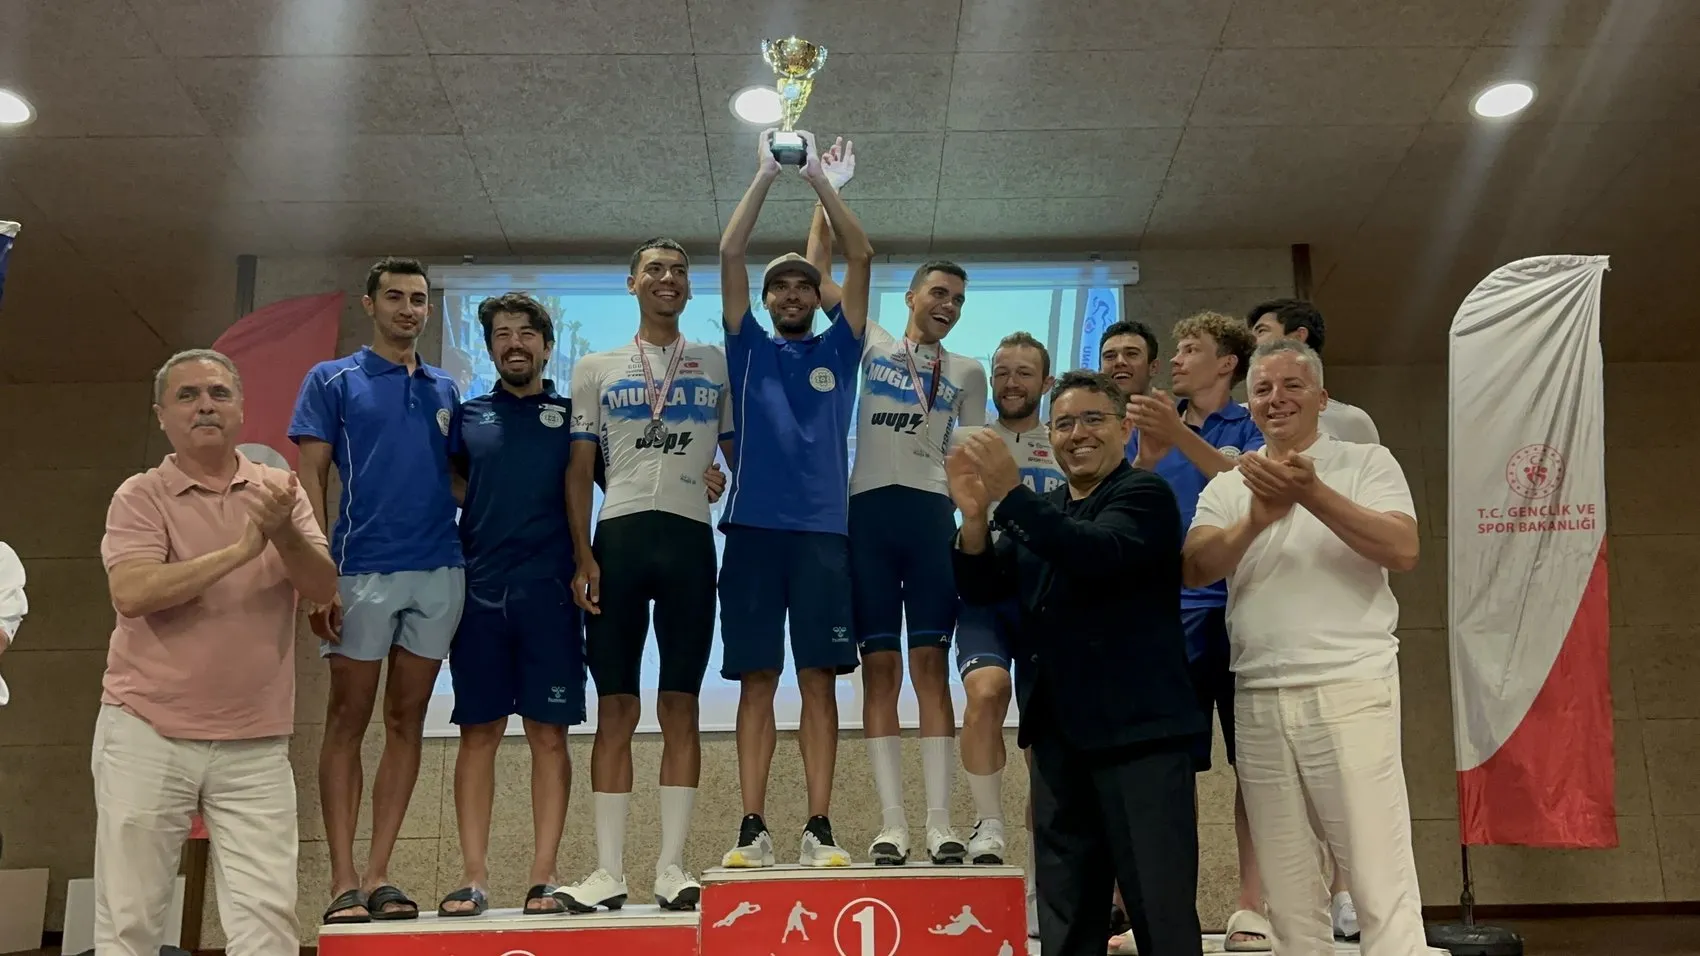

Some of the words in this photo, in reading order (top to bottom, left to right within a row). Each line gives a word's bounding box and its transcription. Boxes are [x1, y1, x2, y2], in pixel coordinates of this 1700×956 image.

[694, 386, 719, 408] BB
[1477, 508, 1503, 519] T.C.
[1576, 503, 1595, 515] VE
[1478, 522, 1514, 534] SPOR
[1518, 517, 1595, 533] BAKANLIĞI
[852, 906, 875, 956] 1
